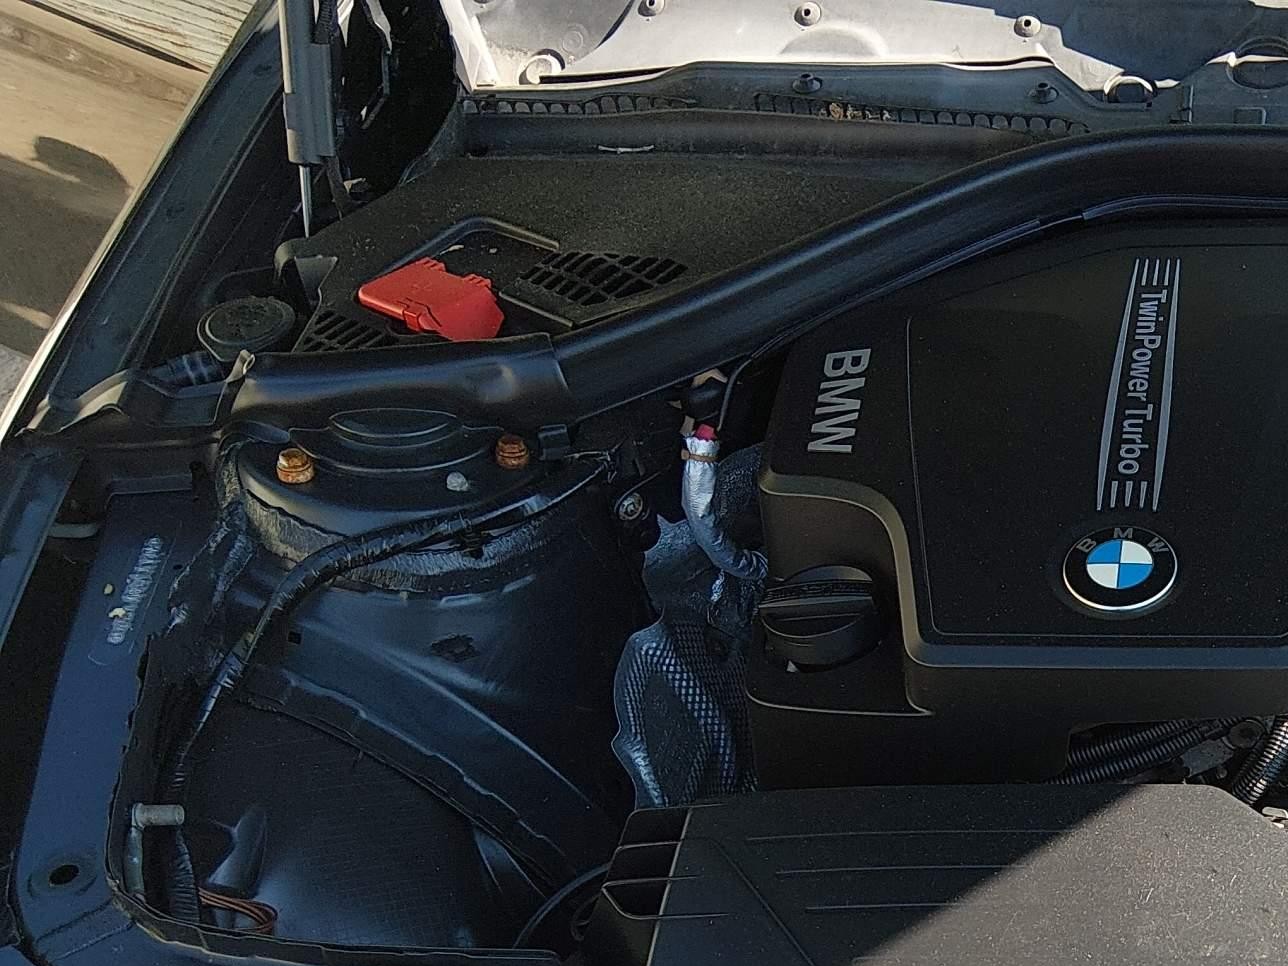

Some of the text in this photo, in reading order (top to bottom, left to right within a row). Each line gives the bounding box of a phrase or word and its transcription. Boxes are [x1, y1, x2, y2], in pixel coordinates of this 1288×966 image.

[807, 348, 872, 454] BMW
[1118, 289, 1168, 475] TwinPower Turbo
[1075, 527, 1170, 553] BMW
